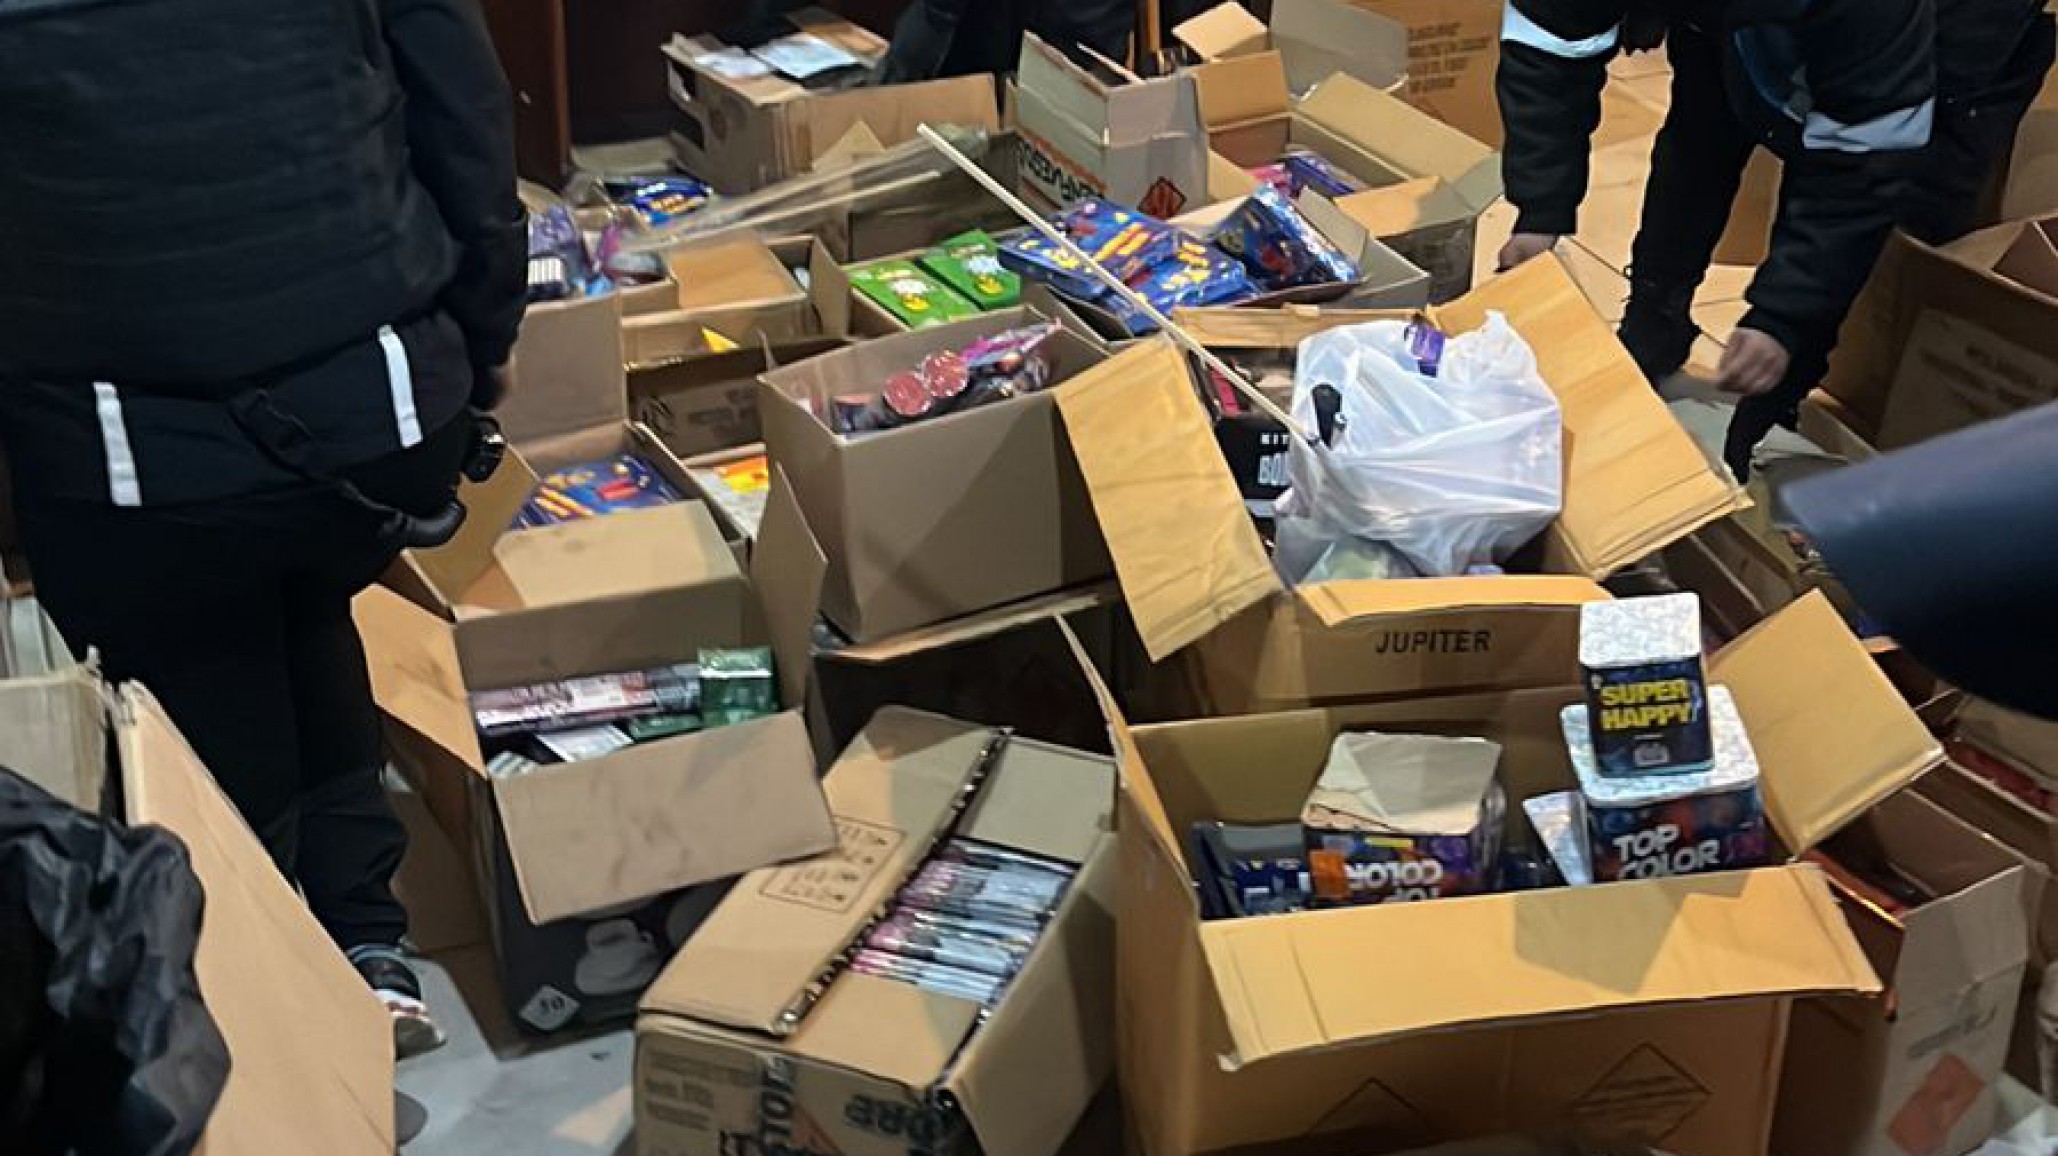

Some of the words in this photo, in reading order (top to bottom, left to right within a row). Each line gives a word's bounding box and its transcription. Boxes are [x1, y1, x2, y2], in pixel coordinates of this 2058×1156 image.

[1375, 629, 1491, 653] JUPITER
[1601, 679, 1690, 705] SUPER
[1601, 702, 1691, 730] HAPPY
[1611, 824, 1680, 862] TOP
